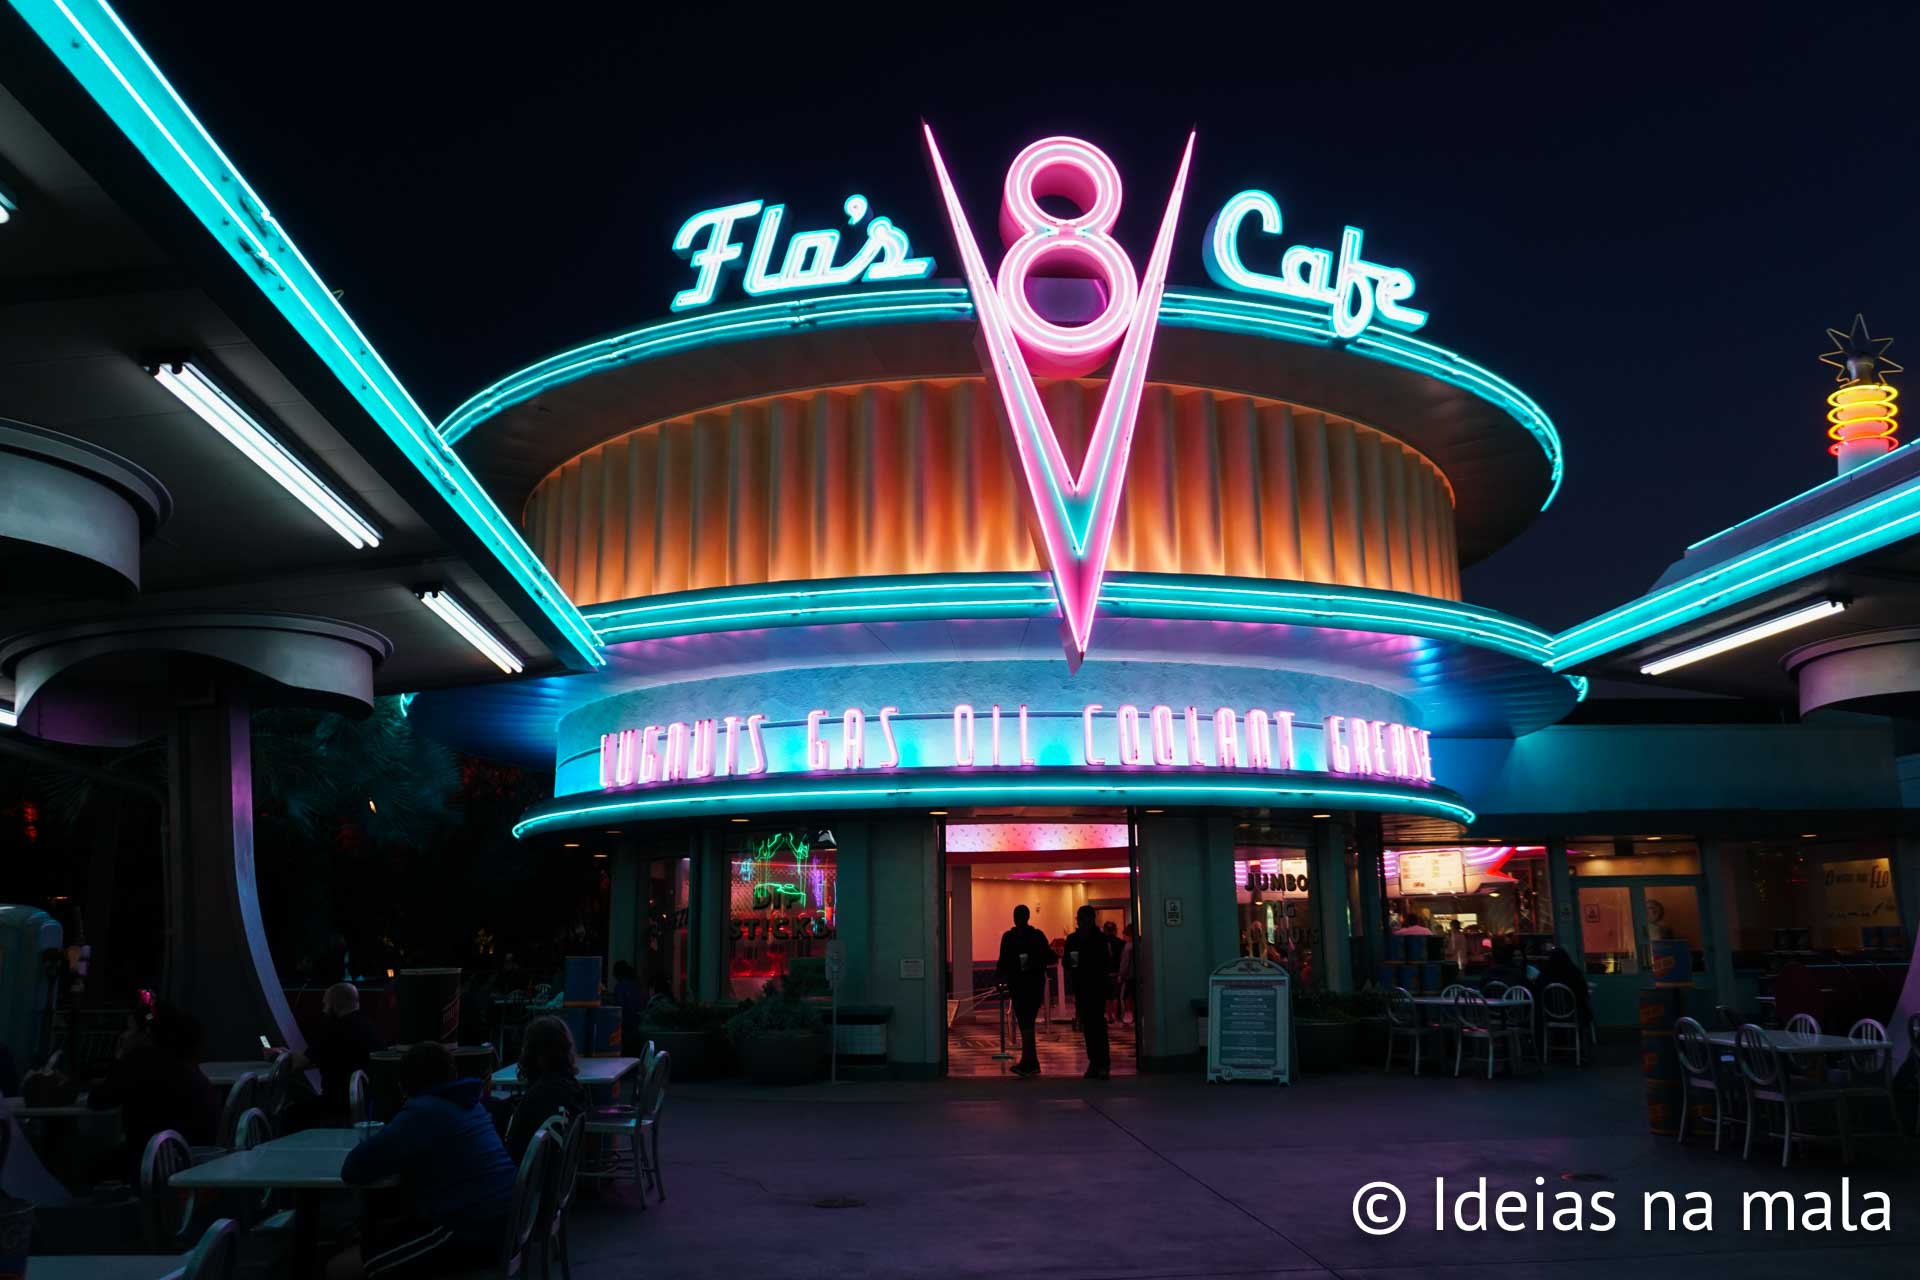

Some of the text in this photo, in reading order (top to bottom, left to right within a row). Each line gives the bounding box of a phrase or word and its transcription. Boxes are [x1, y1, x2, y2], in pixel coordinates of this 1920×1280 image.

[670, 194, 937, 312] Flo's
[1203, 190, 1429, 338] Cafe
[807, 707, 900, 771] GAS
[953, 704, 1035, 767] OIL
[1083, 704, 1297, 770] COOLANT
[1324, 714, 1436, 783] GREASE
[1245, 872, 1309, 892] JUMBO
